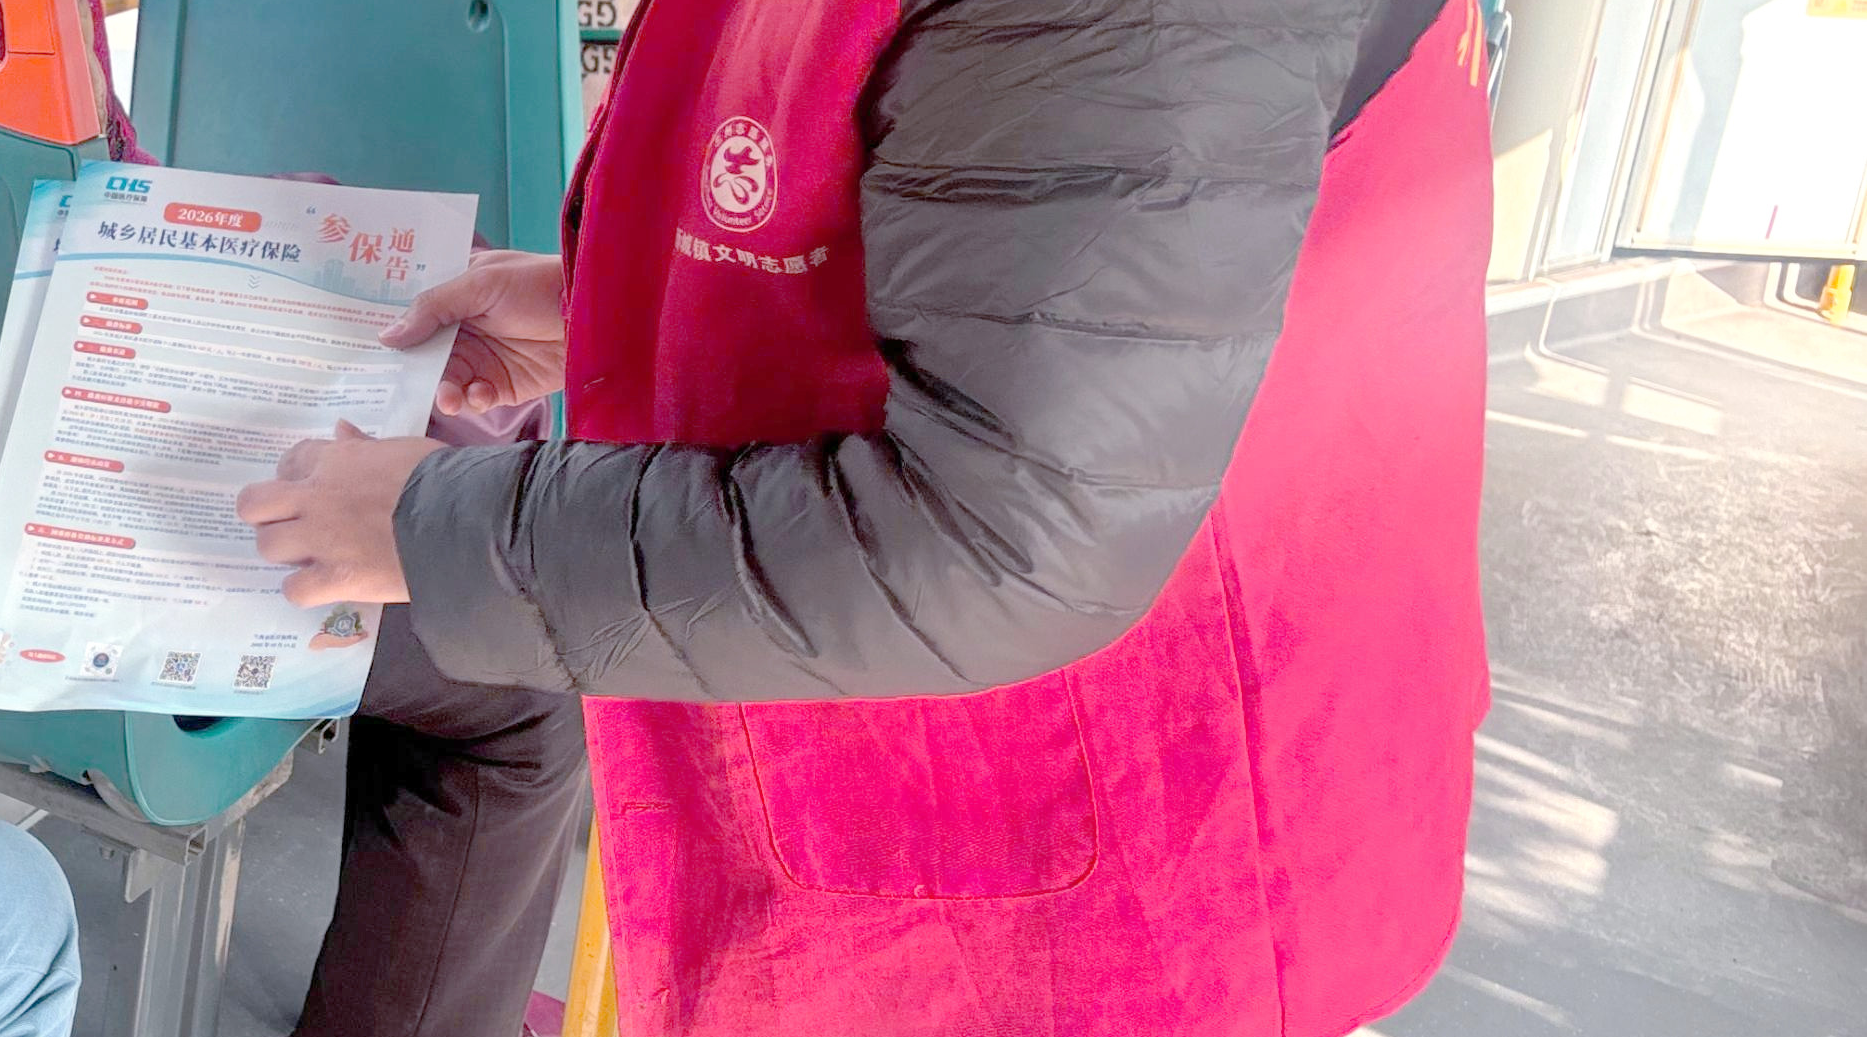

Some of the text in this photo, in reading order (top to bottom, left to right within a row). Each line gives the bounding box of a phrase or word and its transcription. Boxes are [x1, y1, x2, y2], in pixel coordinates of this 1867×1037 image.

[177, 207, 245, 228] 2026年度
[98, 221, 302, 264] 城乡居民基本医疗保险
